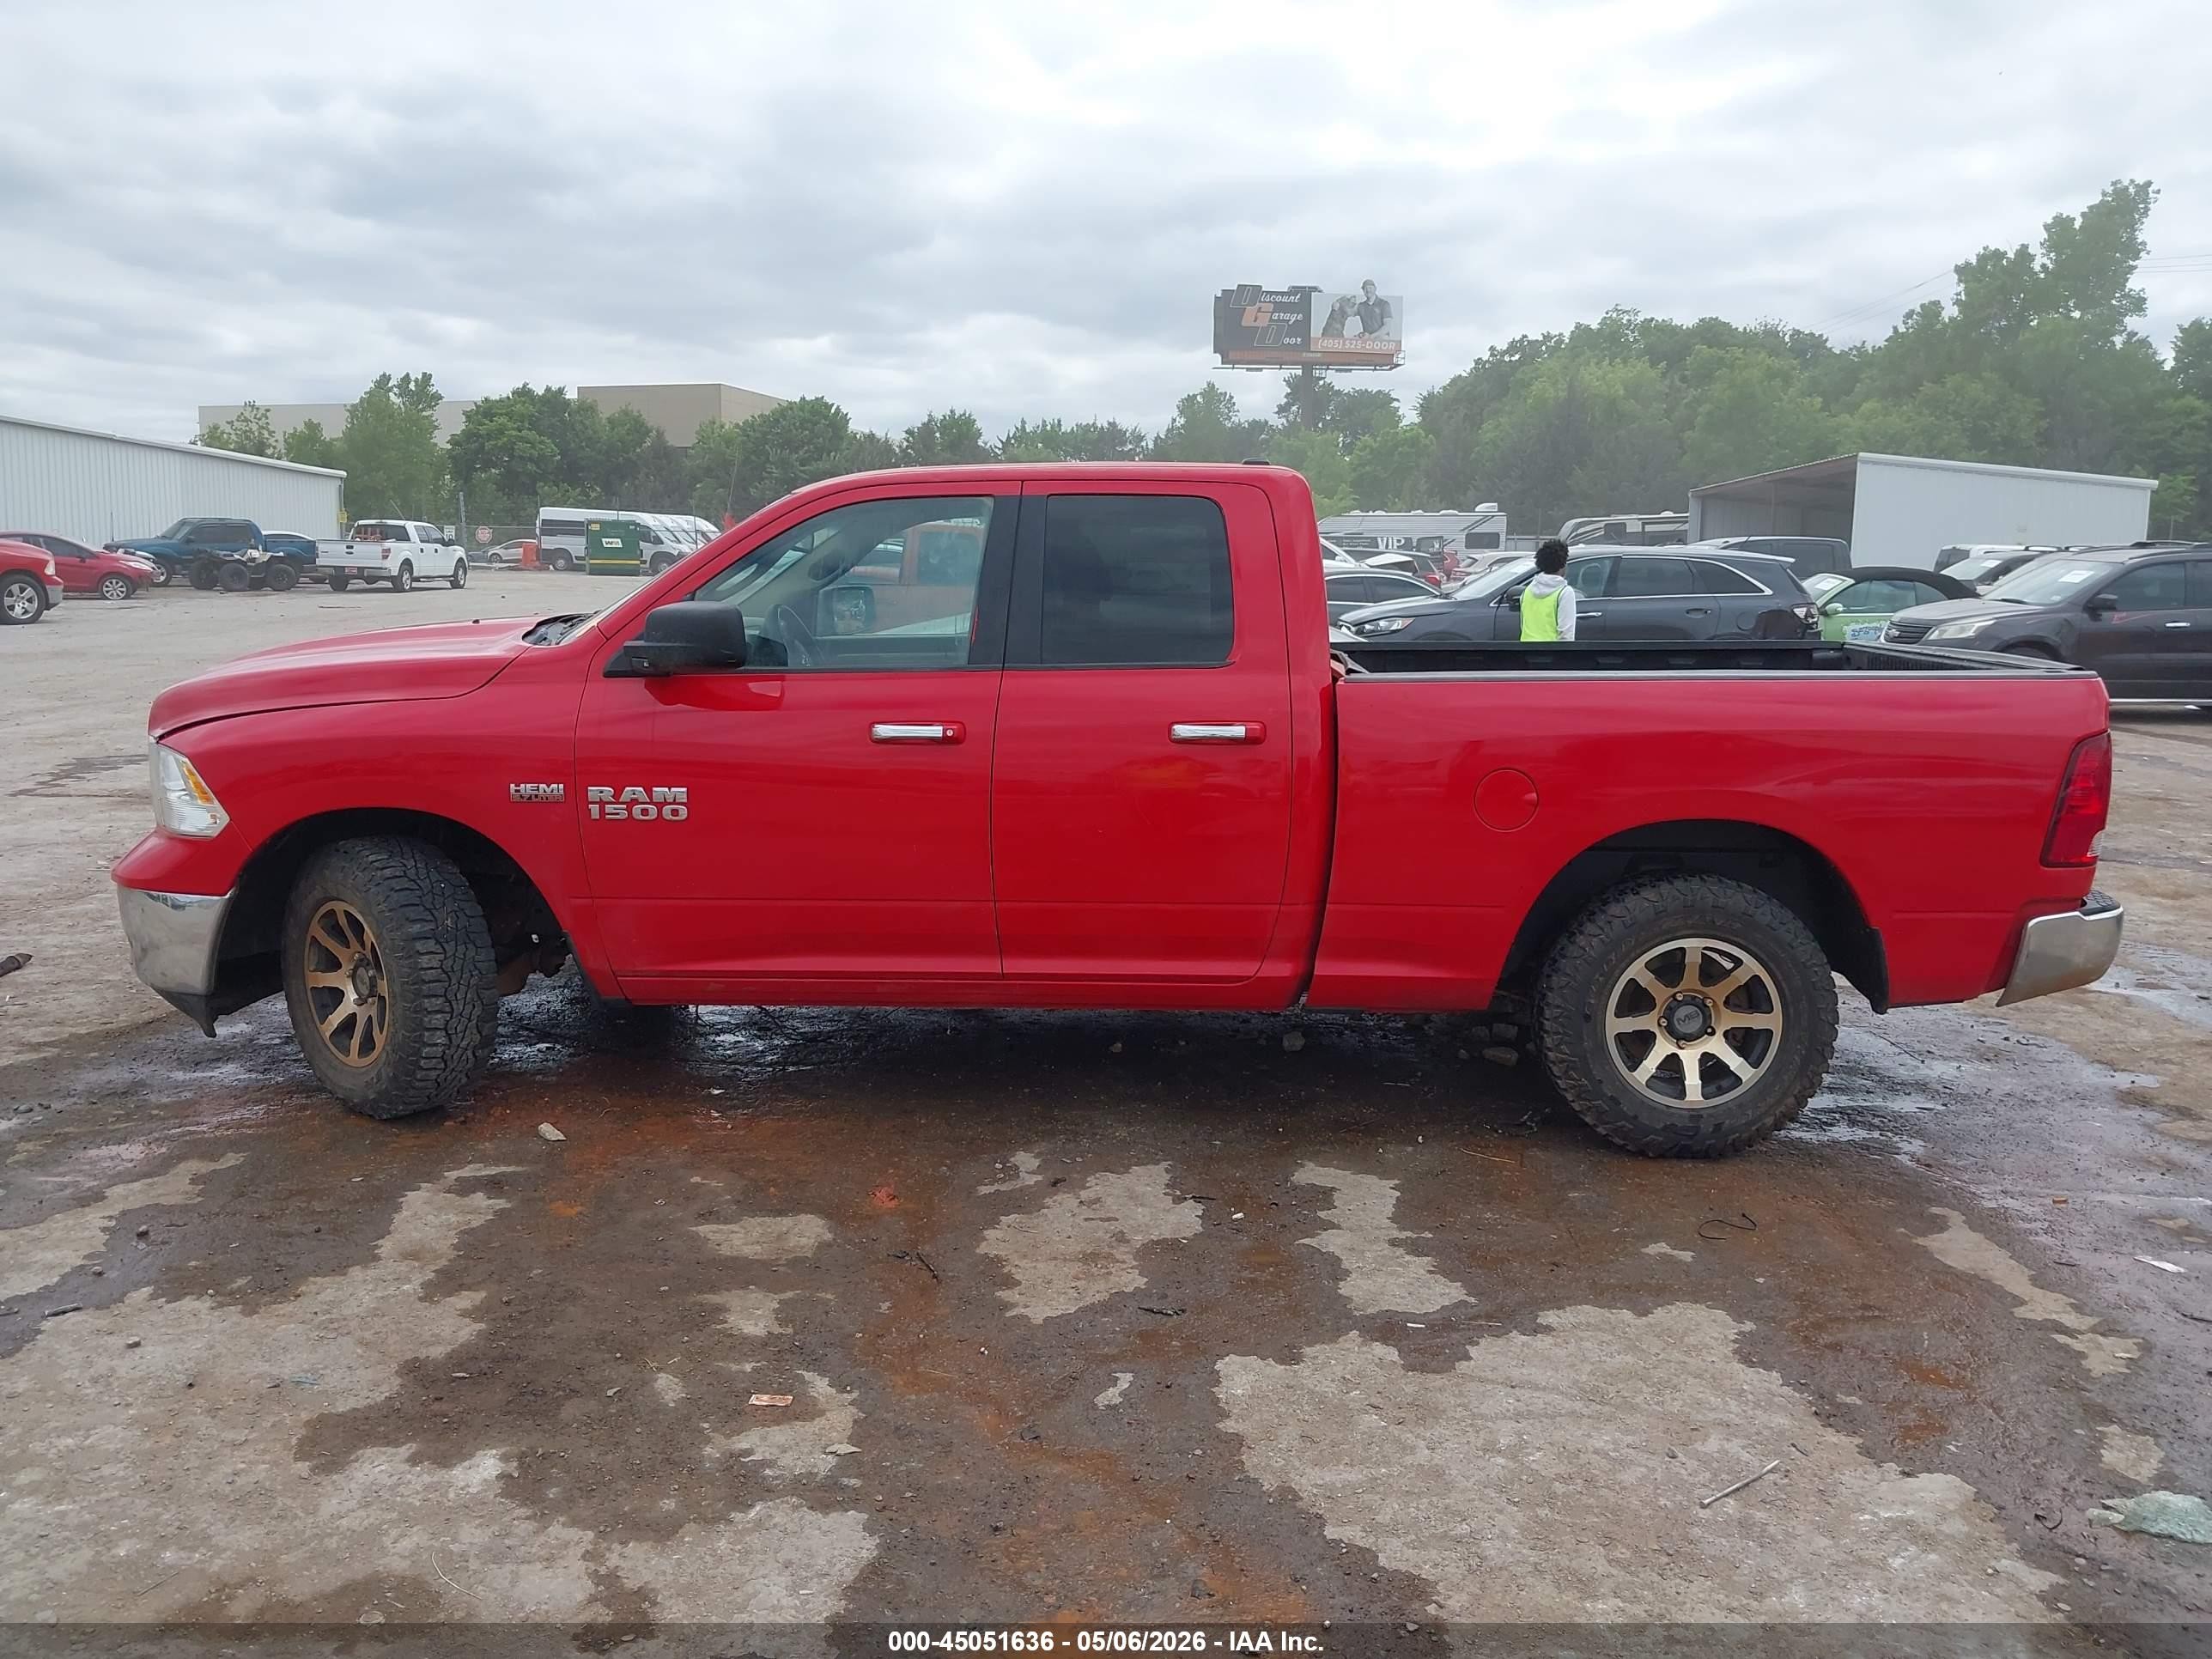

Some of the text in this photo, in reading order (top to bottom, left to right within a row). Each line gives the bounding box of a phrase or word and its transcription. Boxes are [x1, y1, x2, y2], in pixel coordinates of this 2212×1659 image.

[1230, 284, 1301, 308] Discount
[1242, 302, 1304, 327] Garage
[1254, 323, 1303, 347] Door
[1318, 338, 1343, 349] (405)
[1376, 537, 1406, 550] VIP
[509, 783, 564, 793] HEMI
[587, 787, 688, 803] RAM
[588, 804, 689, 821] 1500
